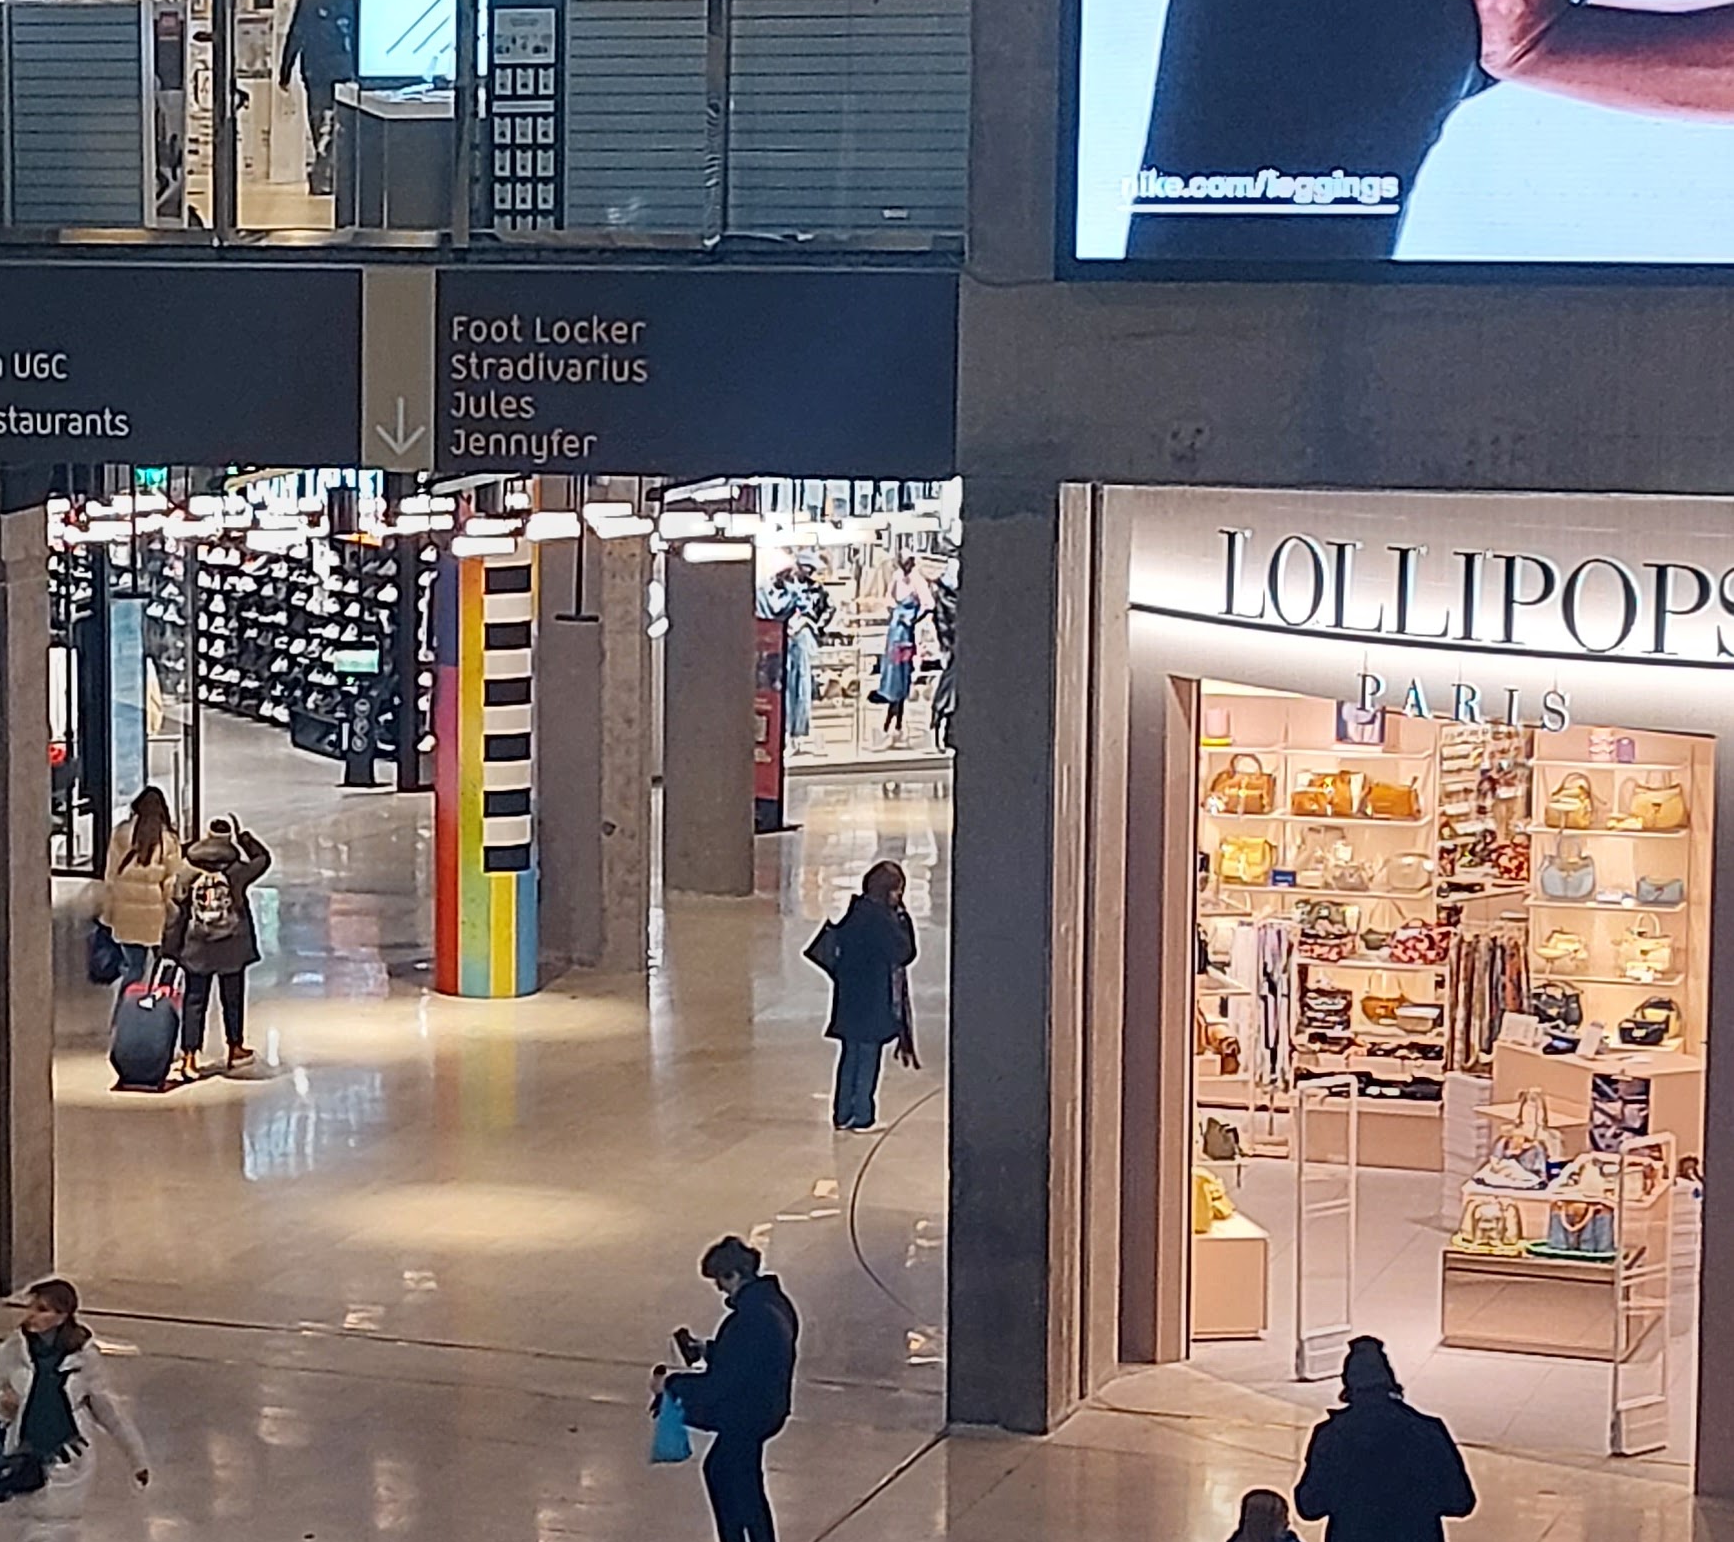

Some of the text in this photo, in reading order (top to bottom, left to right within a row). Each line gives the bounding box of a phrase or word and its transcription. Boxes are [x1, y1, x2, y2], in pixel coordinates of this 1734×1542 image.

[1121, 168, 1399, 204] nike.com/leggings
[451, 314, 647, 344] Foot Locker
[14, 353, 68, 379] UGC
[450, 351, 649, 383] Stradivarius
[450, 389, 536, 419] Jules
[449, 428, 598, 464] Jennyfer
[1357, 671, 1571, 733] PARIS
